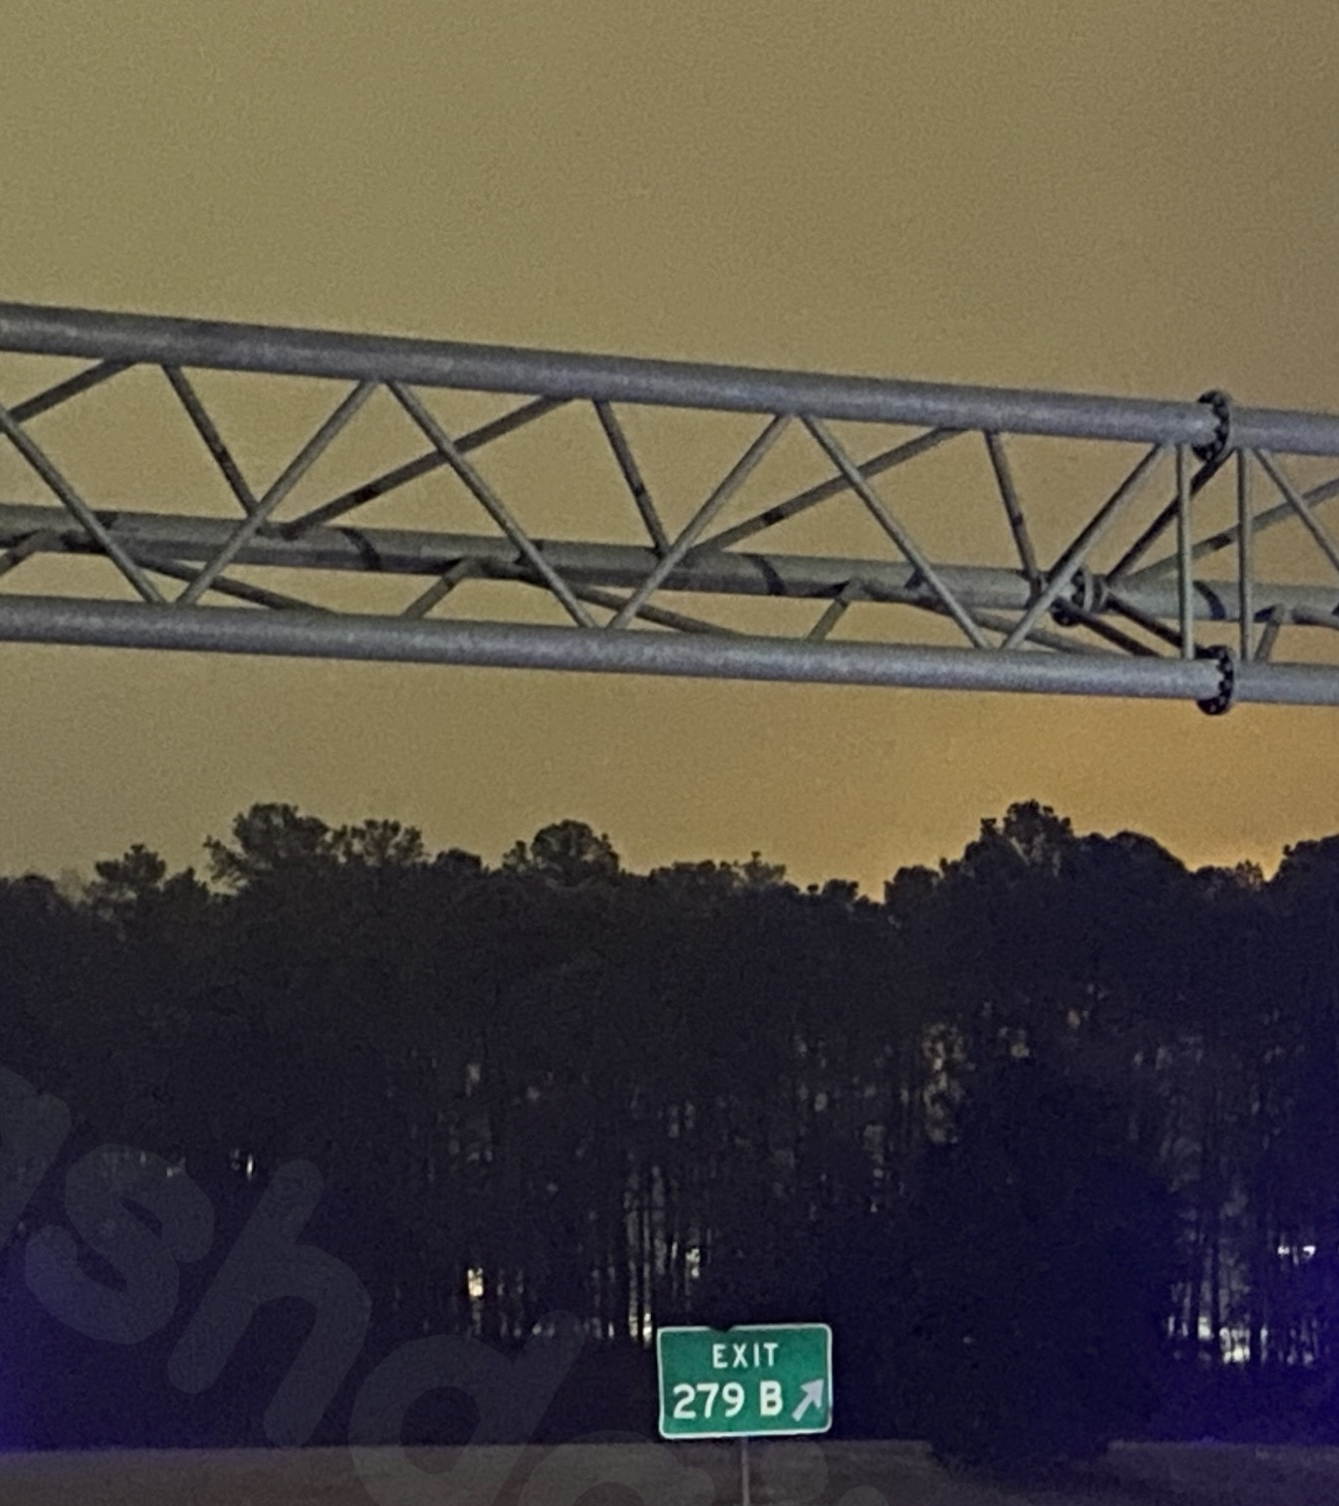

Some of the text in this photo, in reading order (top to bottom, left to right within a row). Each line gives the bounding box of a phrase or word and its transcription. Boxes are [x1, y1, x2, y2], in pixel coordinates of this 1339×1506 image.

[712, 1341, 779, 1369] EXIT
[672, 1380, 783, 1419] 279 B
